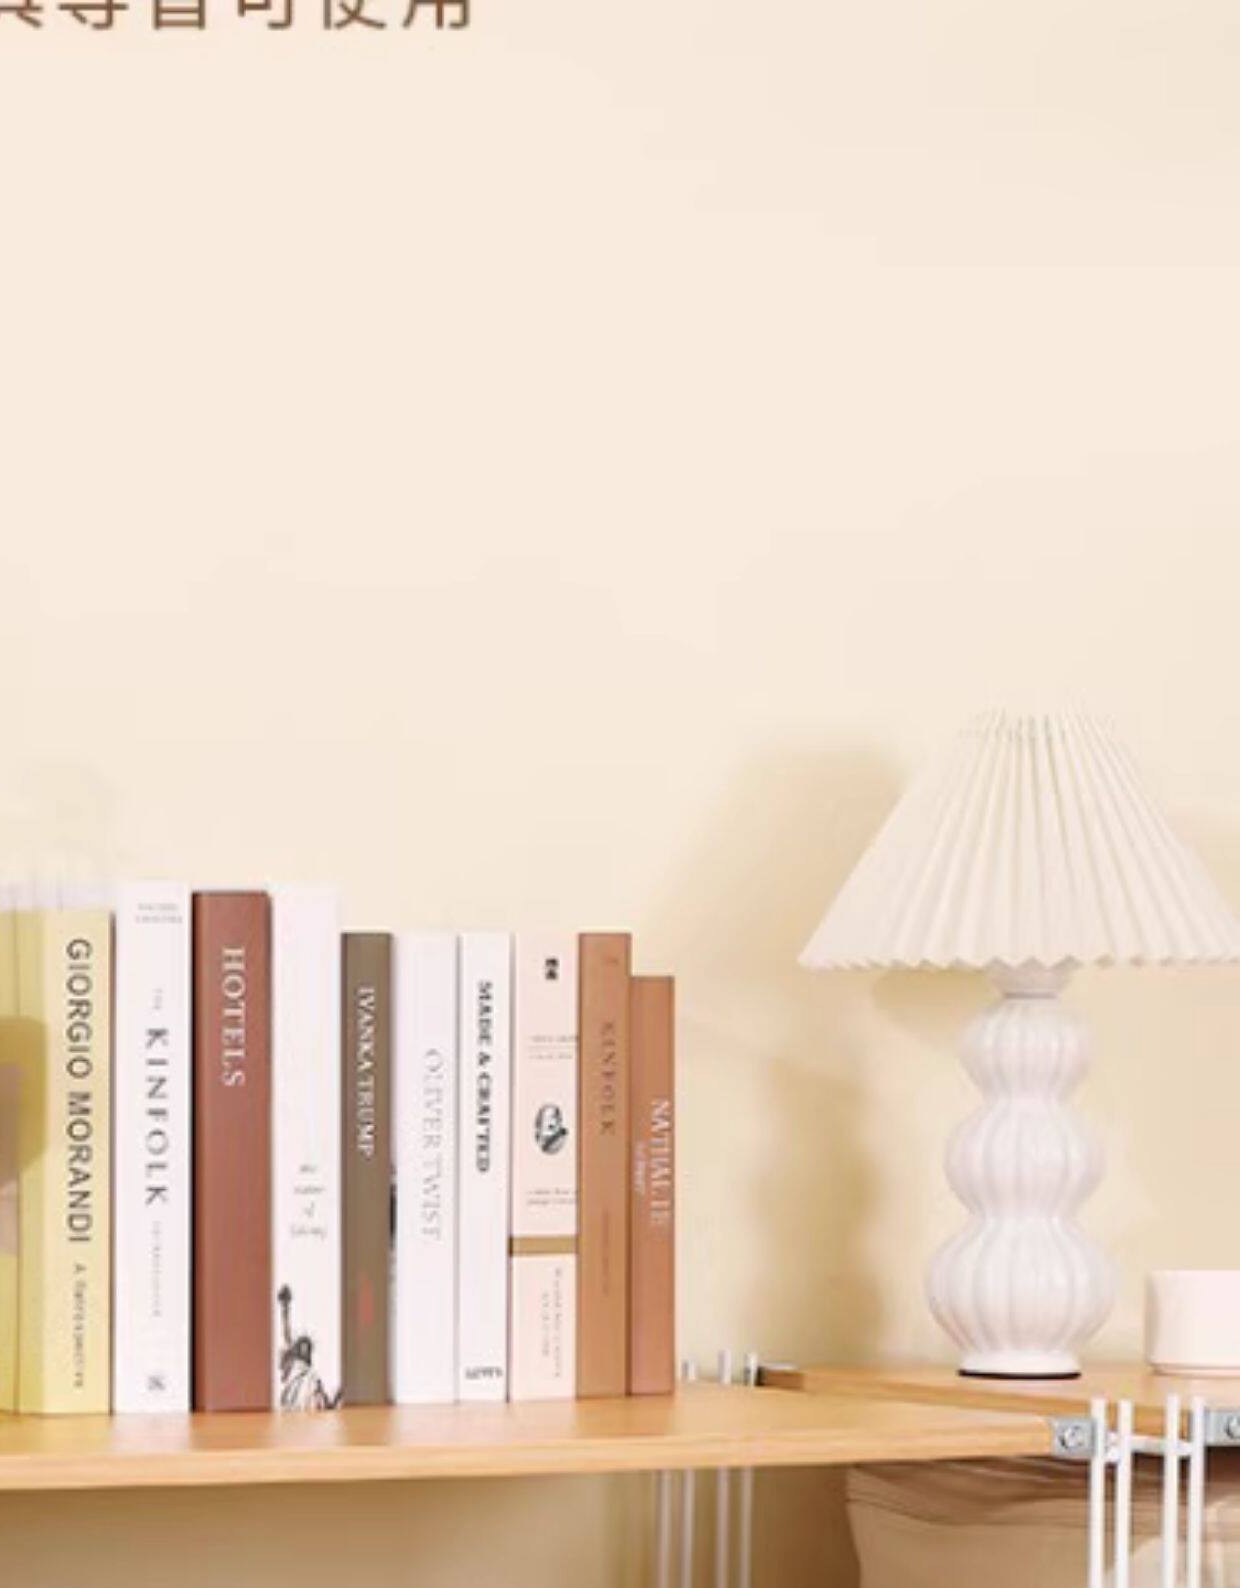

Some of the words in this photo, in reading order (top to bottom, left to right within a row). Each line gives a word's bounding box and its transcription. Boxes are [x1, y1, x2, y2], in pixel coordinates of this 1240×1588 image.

[65, 938, 93, 1080] GIORGIO
[222, 948, 246, 1087] HOTELS
[358, 985, 375, 1071] IVANKA
[477, 981, 493, 1046] MADE
[145, 1027, 169, 1206] KINFOLK
[358, 1074, 375, 1158] TRUMP
[423, 1047, 444, 1149] OLIVER
[476, 1071, 491, 1174] CRAFTED
[601, 1021, 617, 1137] KINFOLK
[65, 1091, 93, 1242] MORANDI
[422, 1159, 442, 1240] TWIST
